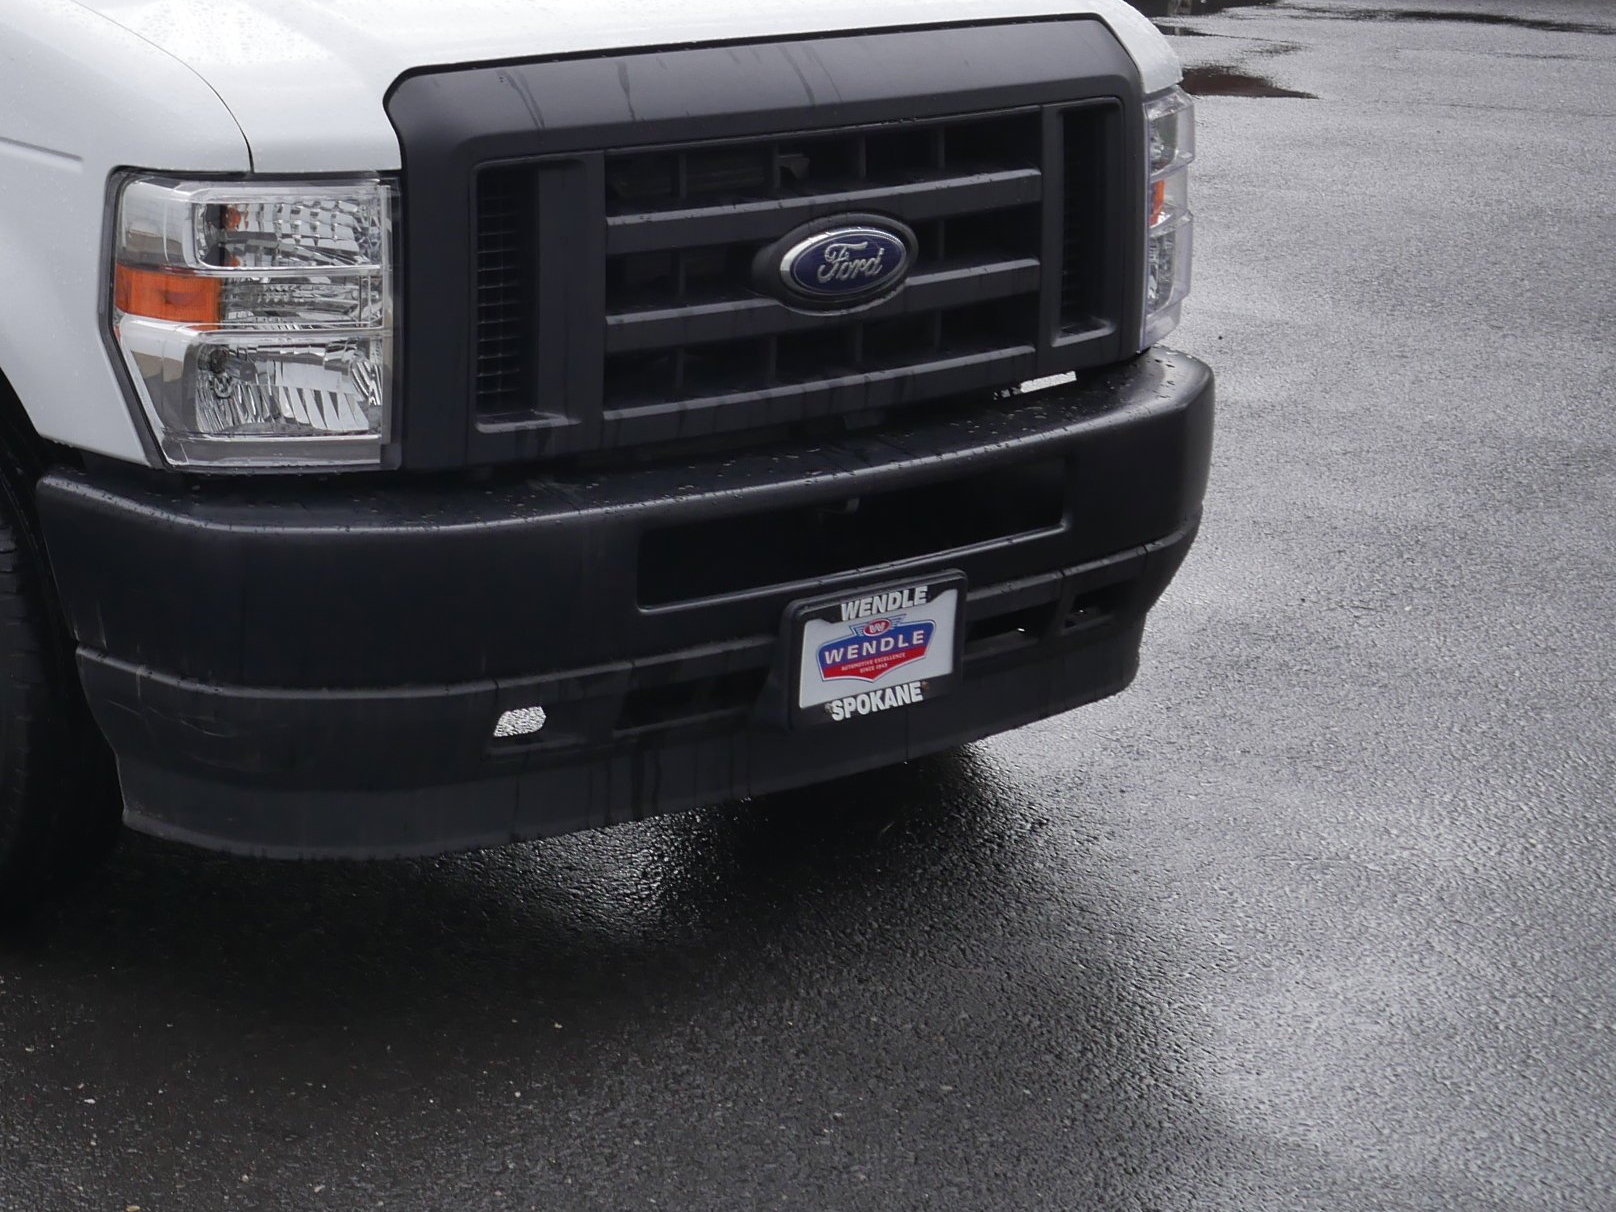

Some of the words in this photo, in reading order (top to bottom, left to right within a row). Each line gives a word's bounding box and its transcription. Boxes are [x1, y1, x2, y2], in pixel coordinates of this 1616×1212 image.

[817, 241, 885, 283] Ford
[841, 585, 928, 621] WENDLE
[824, 630, 925, 665] WENDLE
[831, 681, 924, 721] SPOKANE
